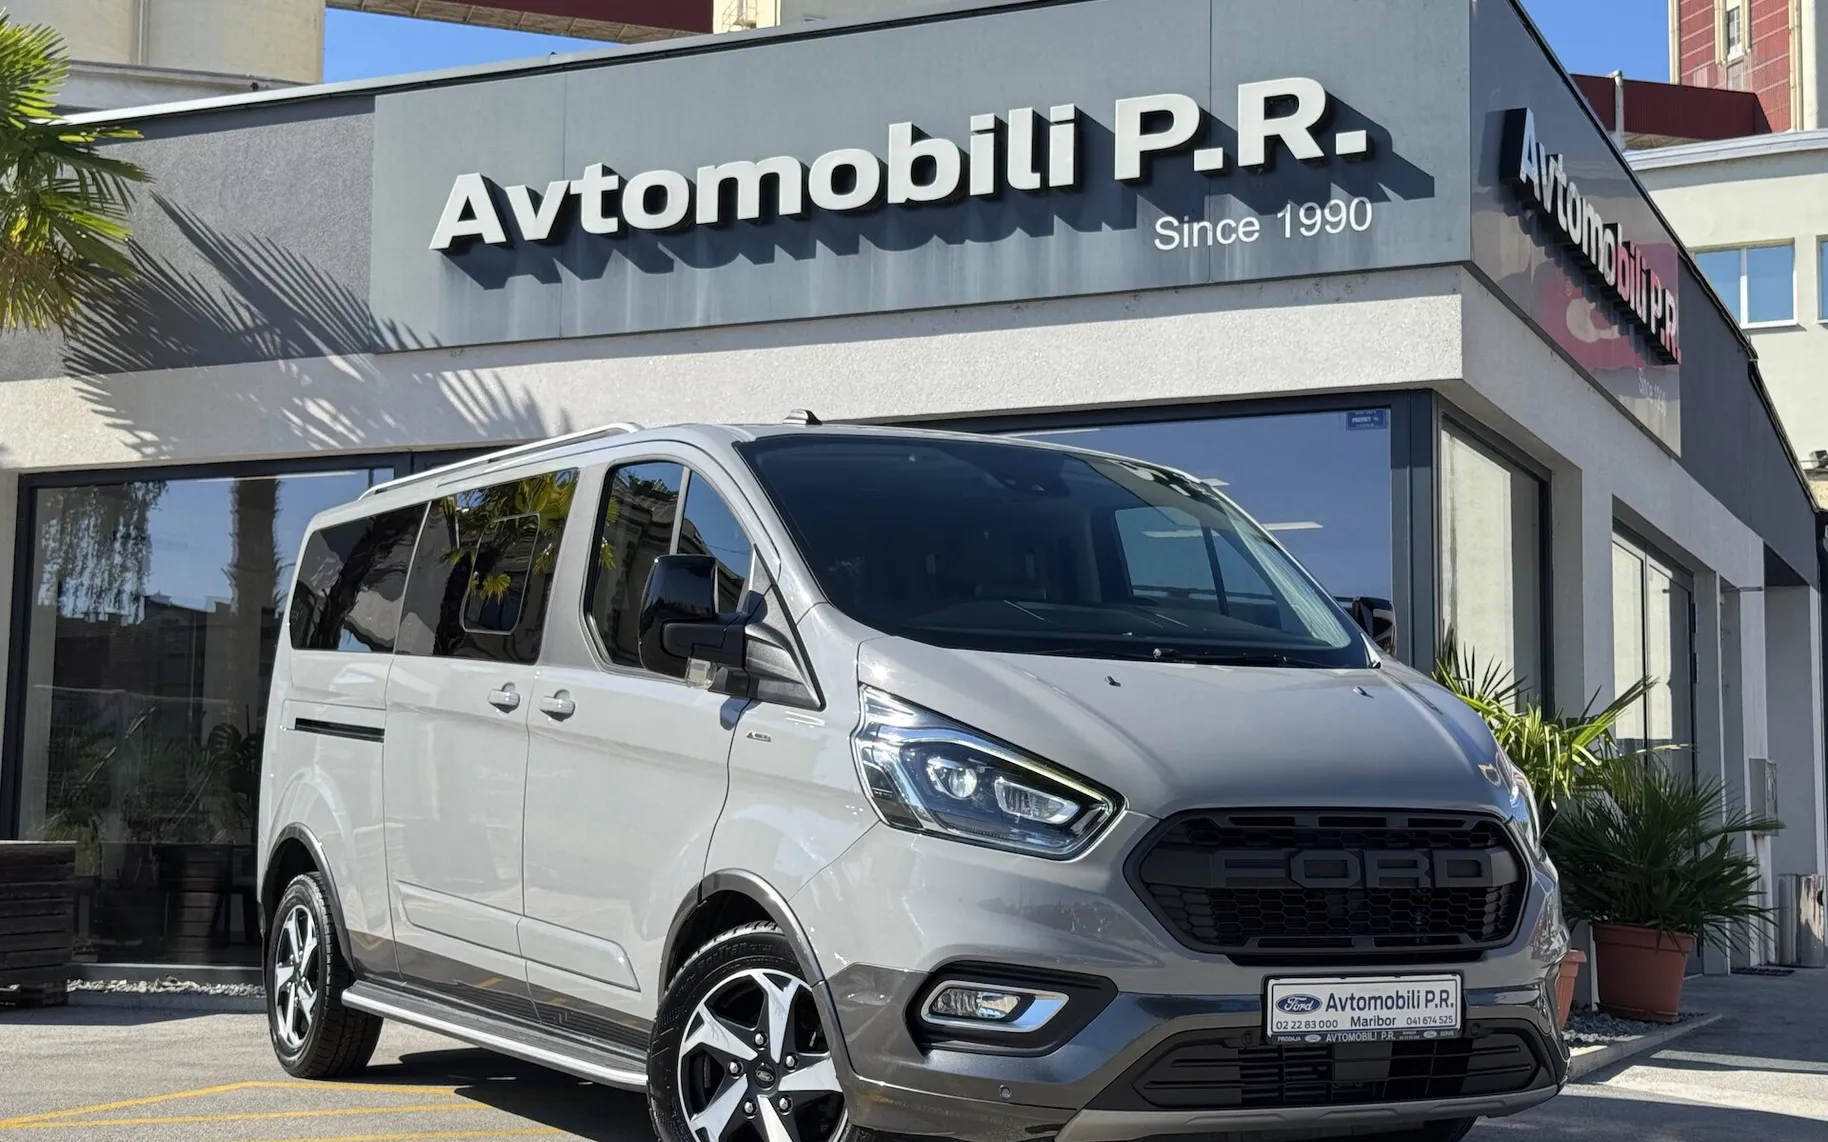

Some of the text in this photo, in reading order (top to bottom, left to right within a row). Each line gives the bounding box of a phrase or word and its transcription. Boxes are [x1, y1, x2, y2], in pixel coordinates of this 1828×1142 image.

[430, 77, 1368, 251] Avtomobili P.R.
[1153, 199, 1374, 252] Since 1990
[1519, 107, 1647, 325] Avtomobili
[1211, 847, 1491, 888] FORD
[1283, 996, 1315, 1012] Ford
[1325, 989, 1454, 1012] Avtomobili P.R.
[1276, 1019, 1339, 1030] 02 22 83 000
[1350, 1015, 1397, 1028] Maribor
[1406, 1015, 1454, 1026] 041 674 525
[1326, 1032, 1377, 1042] AVTOMOBILI
[1381, 1031, 1397, 1041] P.R.
